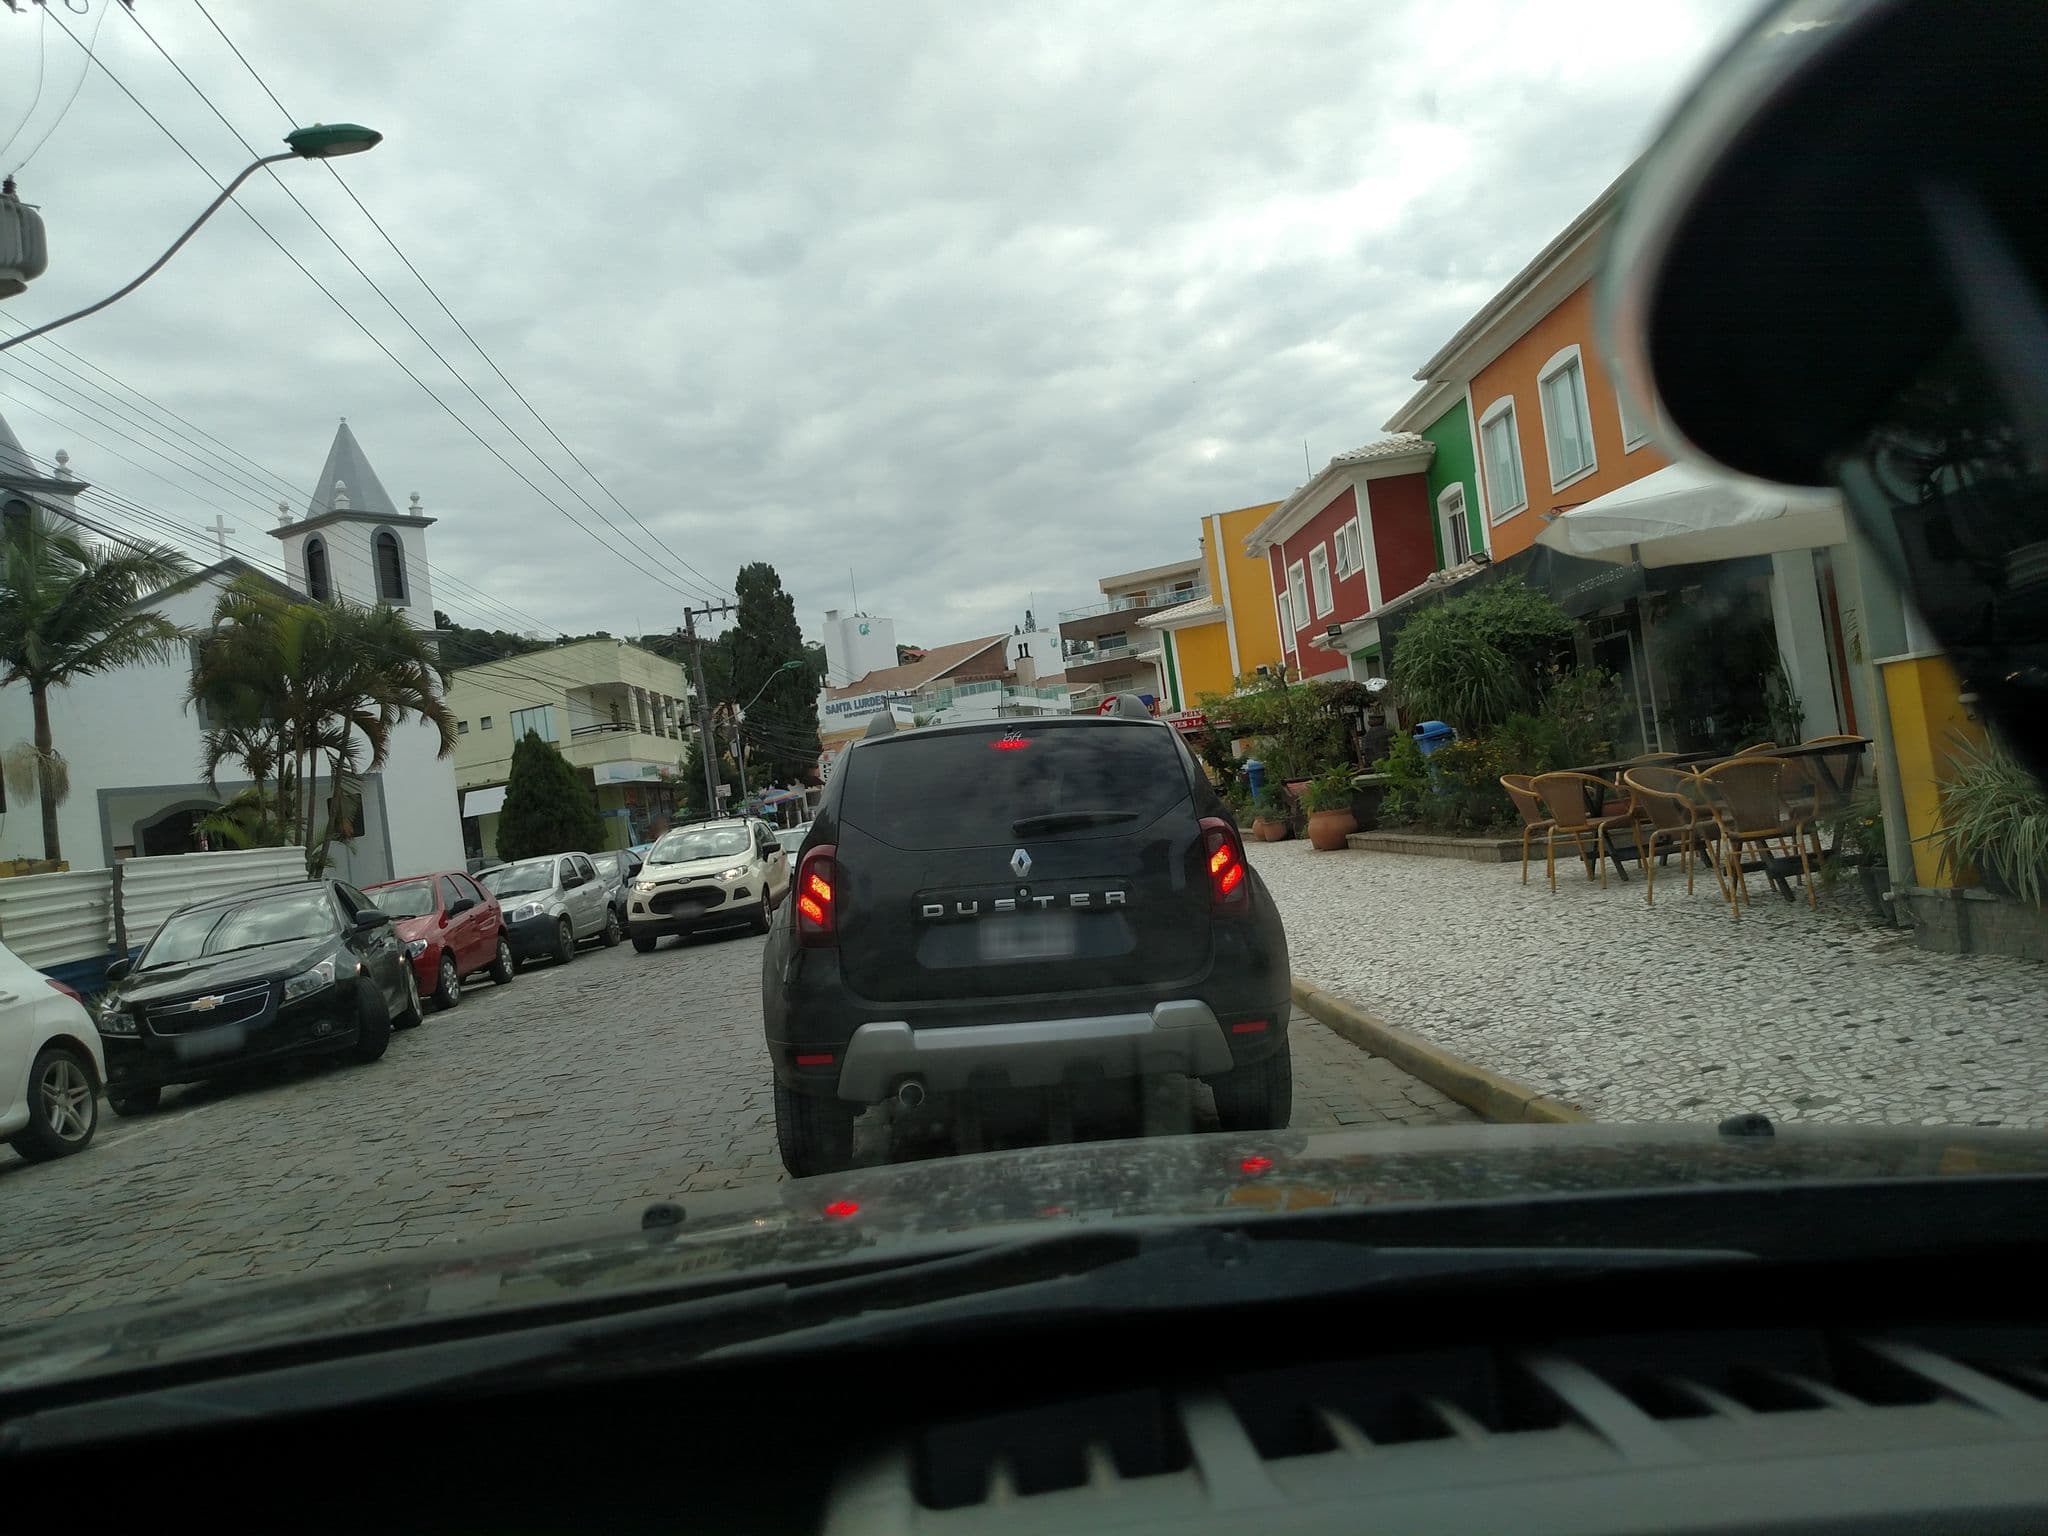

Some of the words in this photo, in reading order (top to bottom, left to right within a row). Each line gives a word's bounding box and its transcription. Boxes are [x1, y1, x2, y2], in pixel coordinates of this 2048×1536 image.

[825, 702, 852, 715] SANTA
[854, 695, 887, 709] LURDES
[922, 890, 1127, 918] DUSTER
